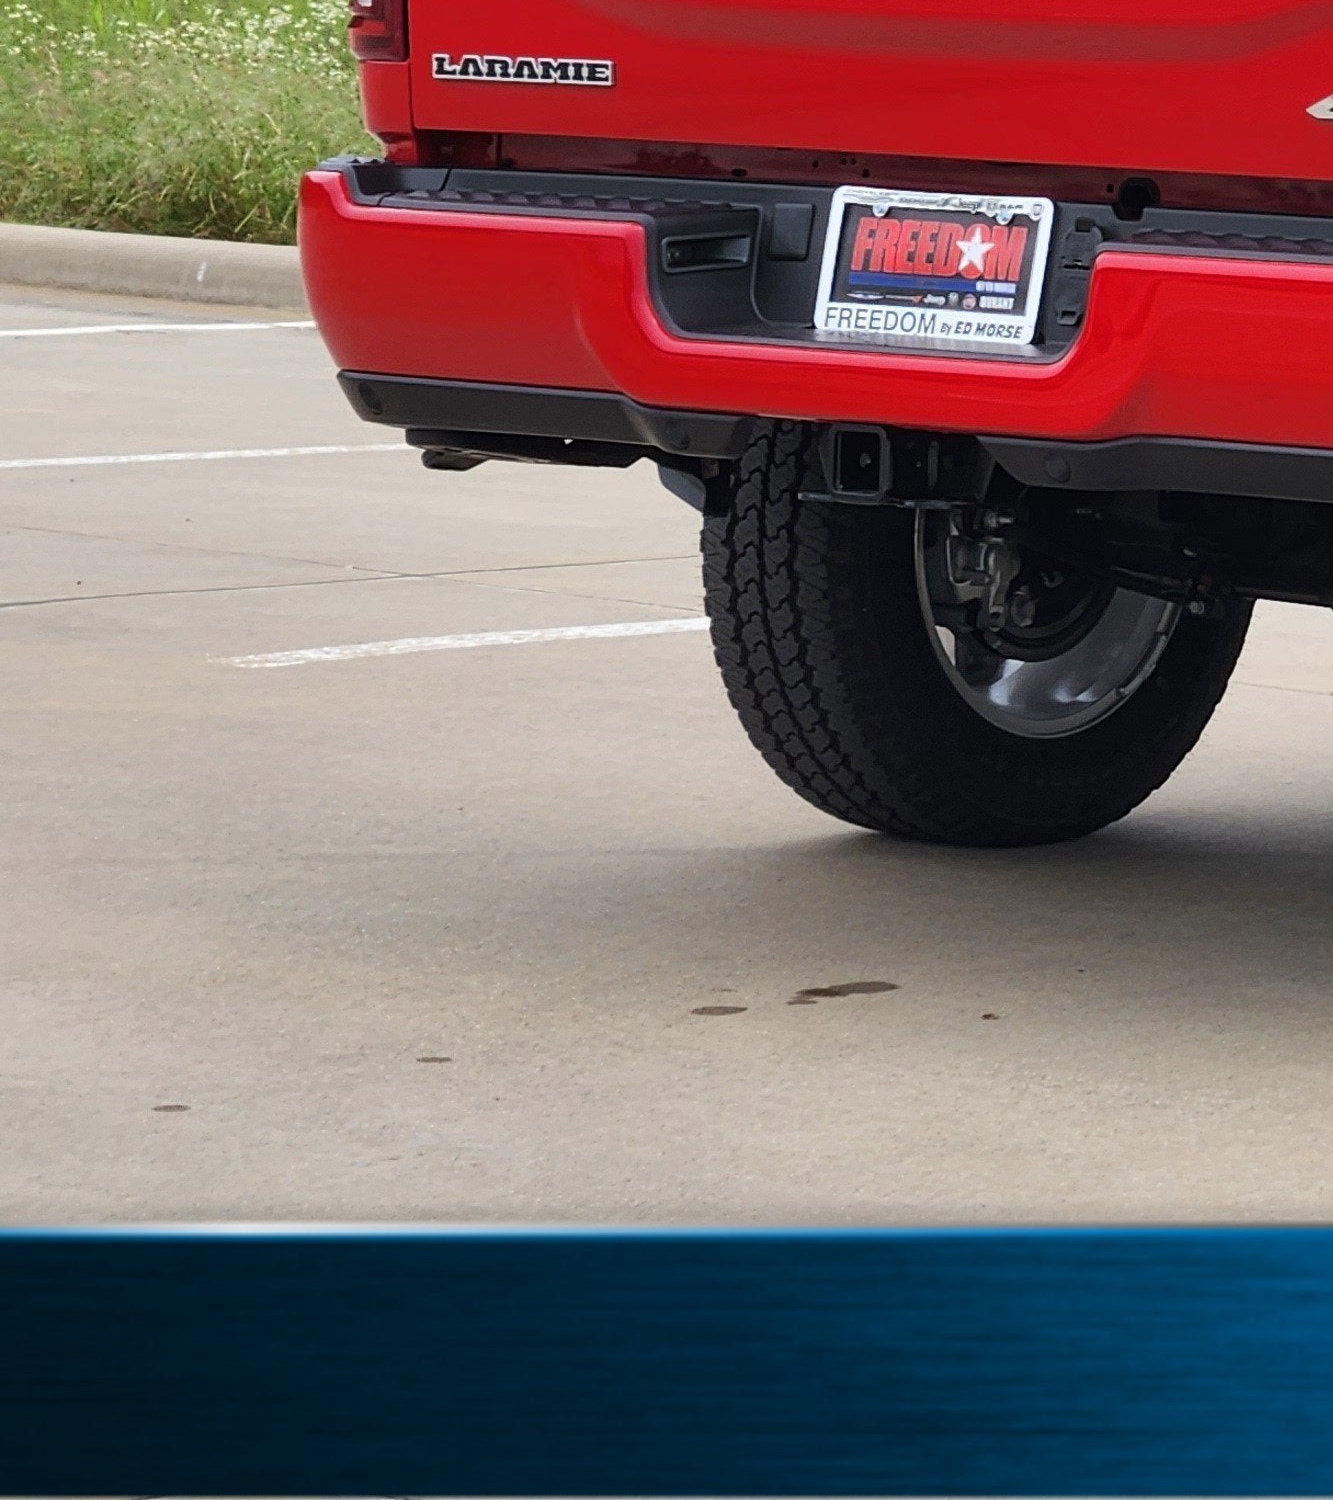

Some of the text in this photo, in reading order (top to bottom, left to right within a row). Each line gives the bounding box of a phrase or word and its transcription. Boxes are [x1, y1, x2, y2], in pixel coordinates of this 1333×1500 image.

[432, 53, 615, 86] LARAMIE
[851, 216, 1029, 282] FREEDOM
[824, 306, 937, 335] FREEDOM
[953, 320, 973, 335] ED
[974, 322, 1024, 340] MORSE
